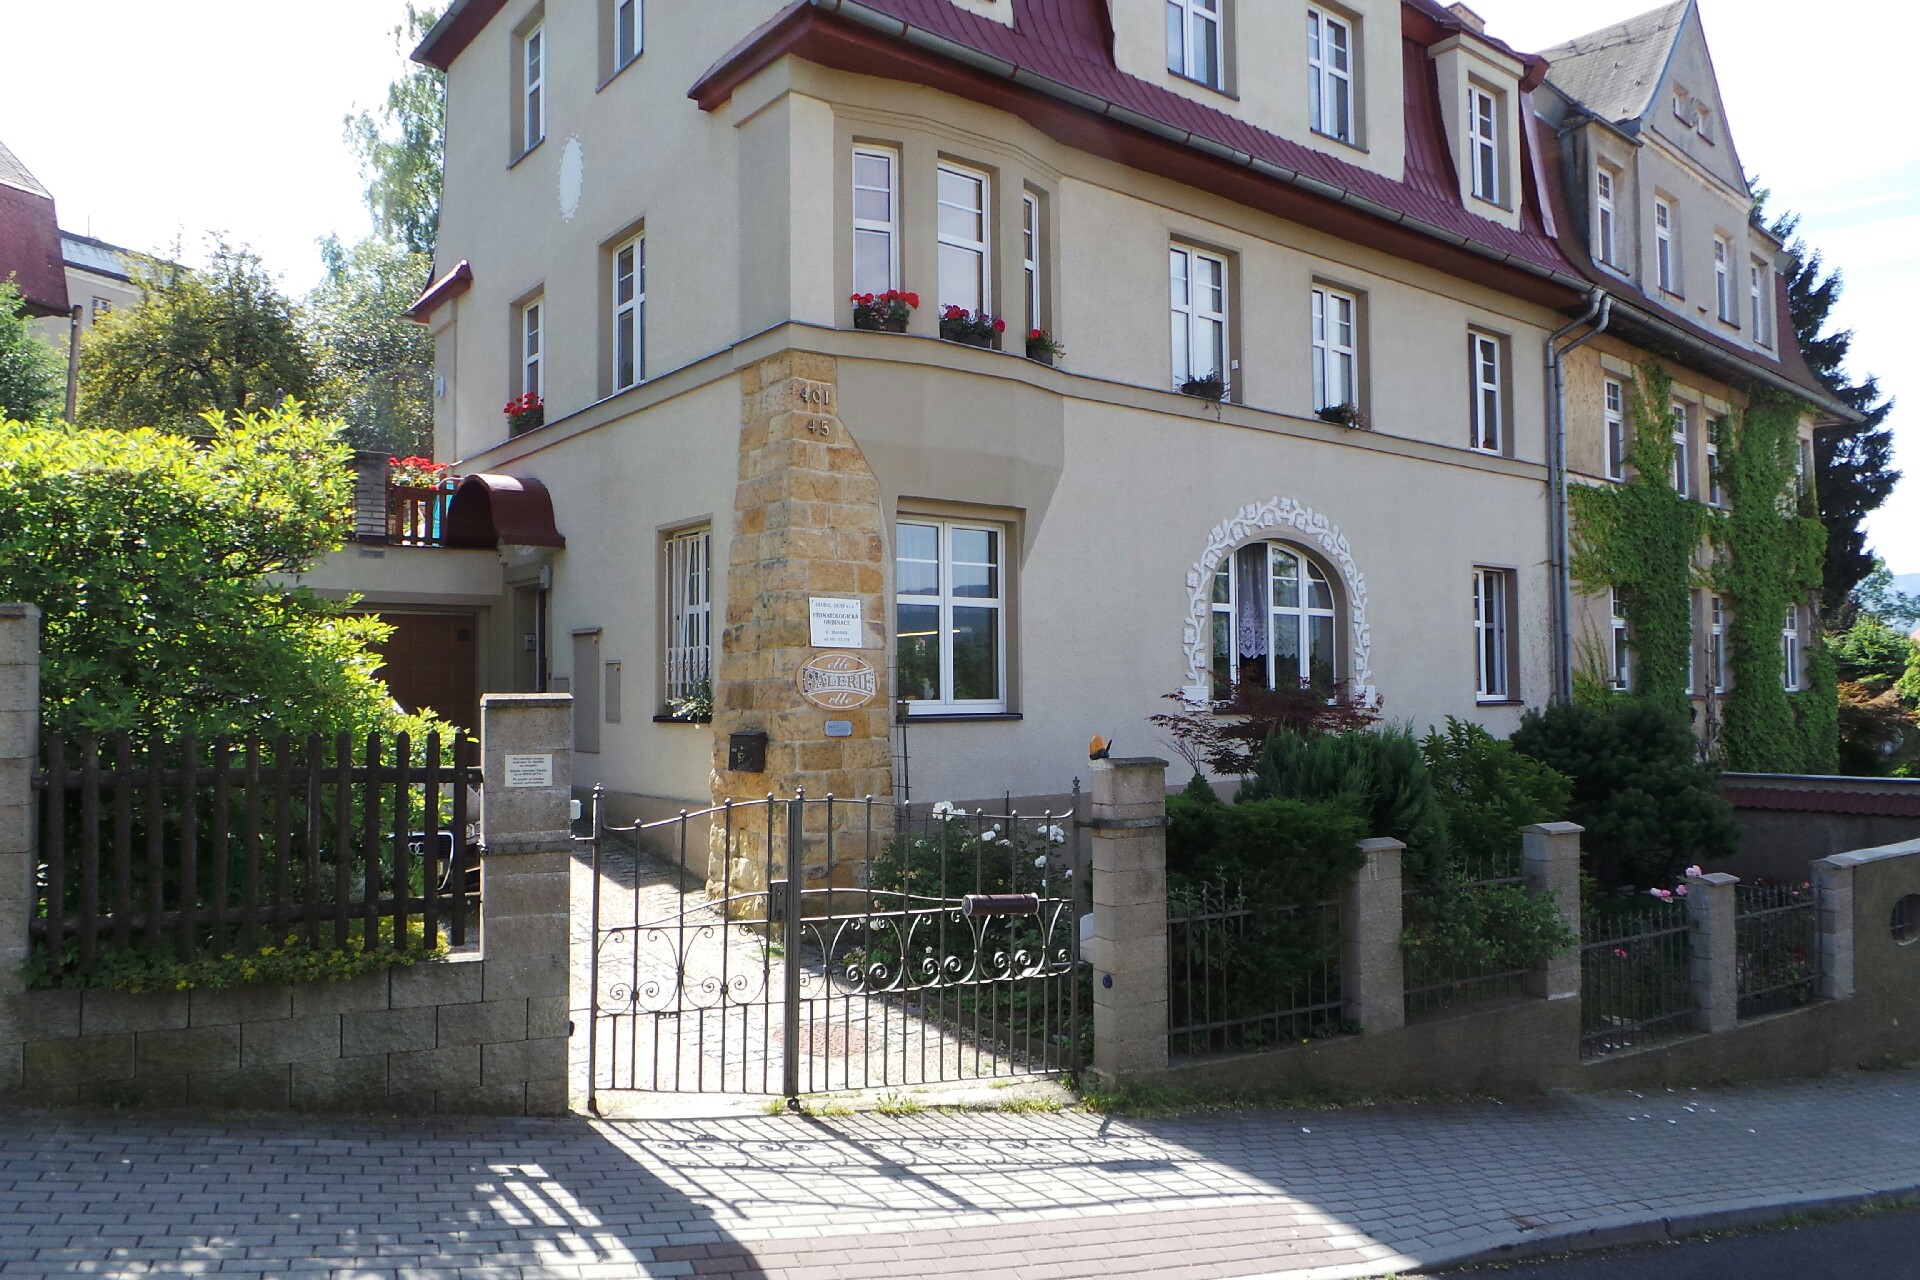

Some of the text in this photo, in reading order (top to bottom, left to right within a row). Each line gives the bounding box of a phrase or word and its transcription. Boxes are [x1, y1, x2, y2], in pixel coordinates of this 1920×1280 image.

[800, 387, 829, 405] 401
[808, 419, 830, 436] 45
[804, 669, 874, 691] GALERIE
